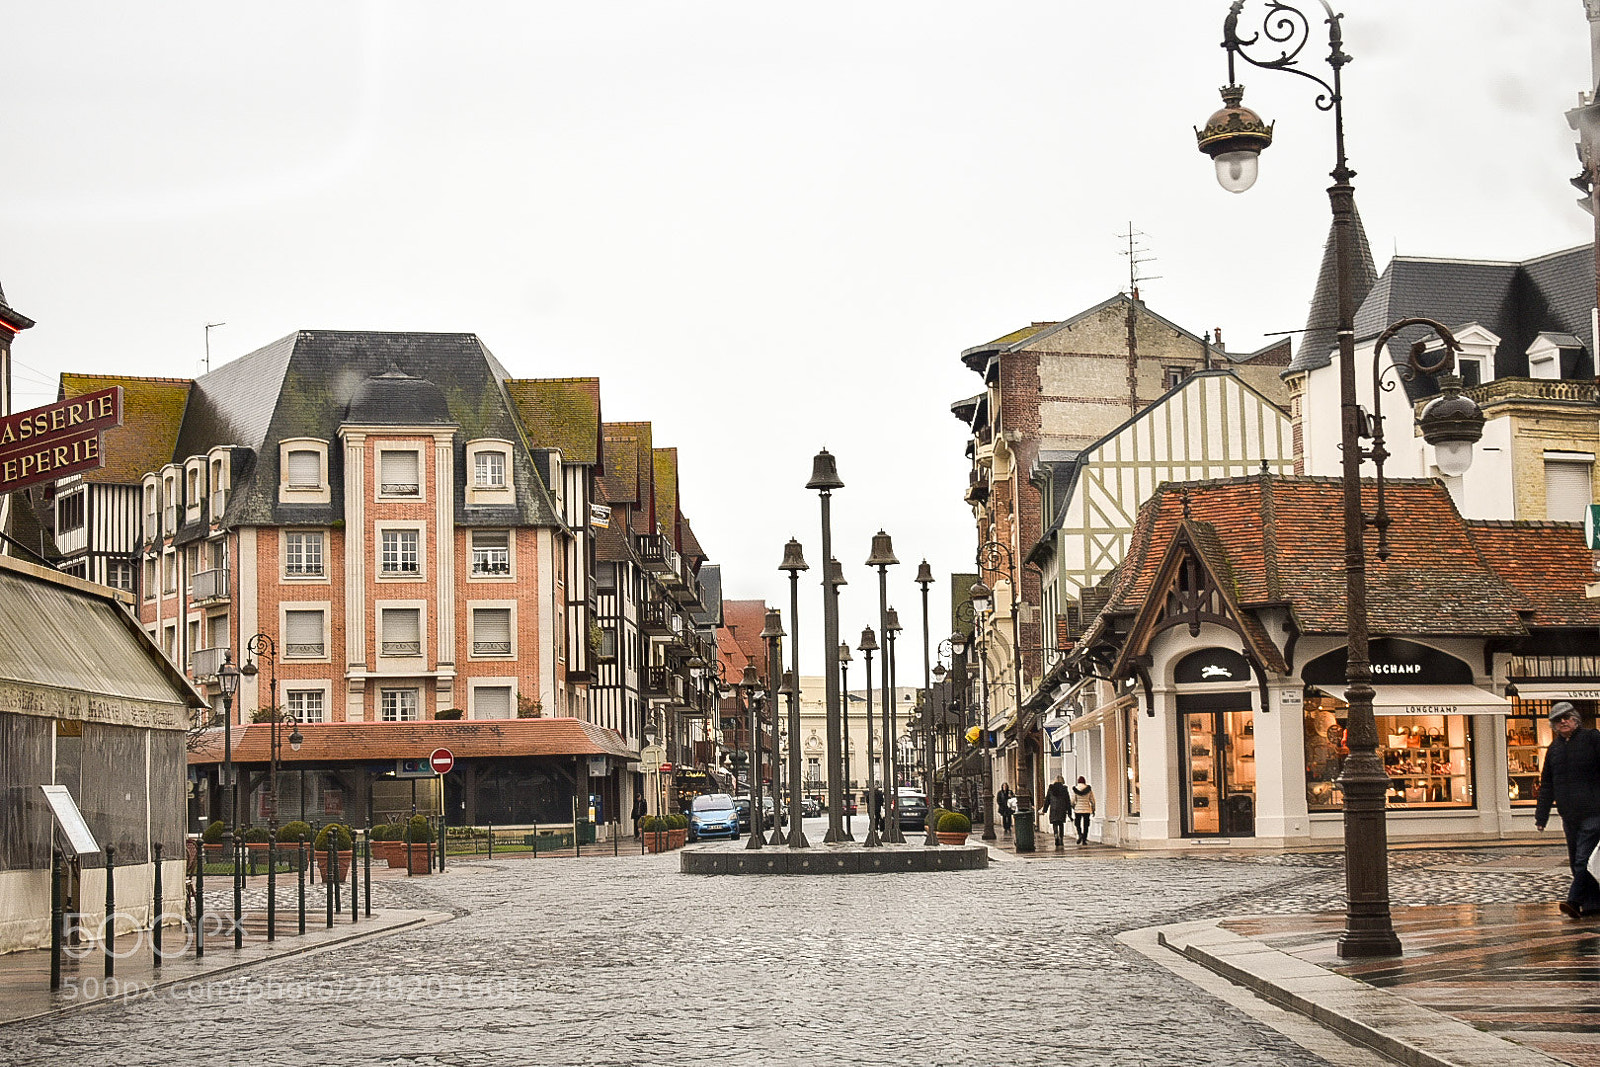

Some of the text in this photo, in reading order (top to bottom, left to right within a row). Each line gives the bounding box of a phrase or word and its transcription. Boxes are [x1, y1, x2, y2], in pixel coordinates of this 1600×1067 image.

[1, 393, 114, 446] ASSERIE
[2, 435, 99, 482] EPERIE
[1405, 706, 1458, 714] LONGCHAMP
